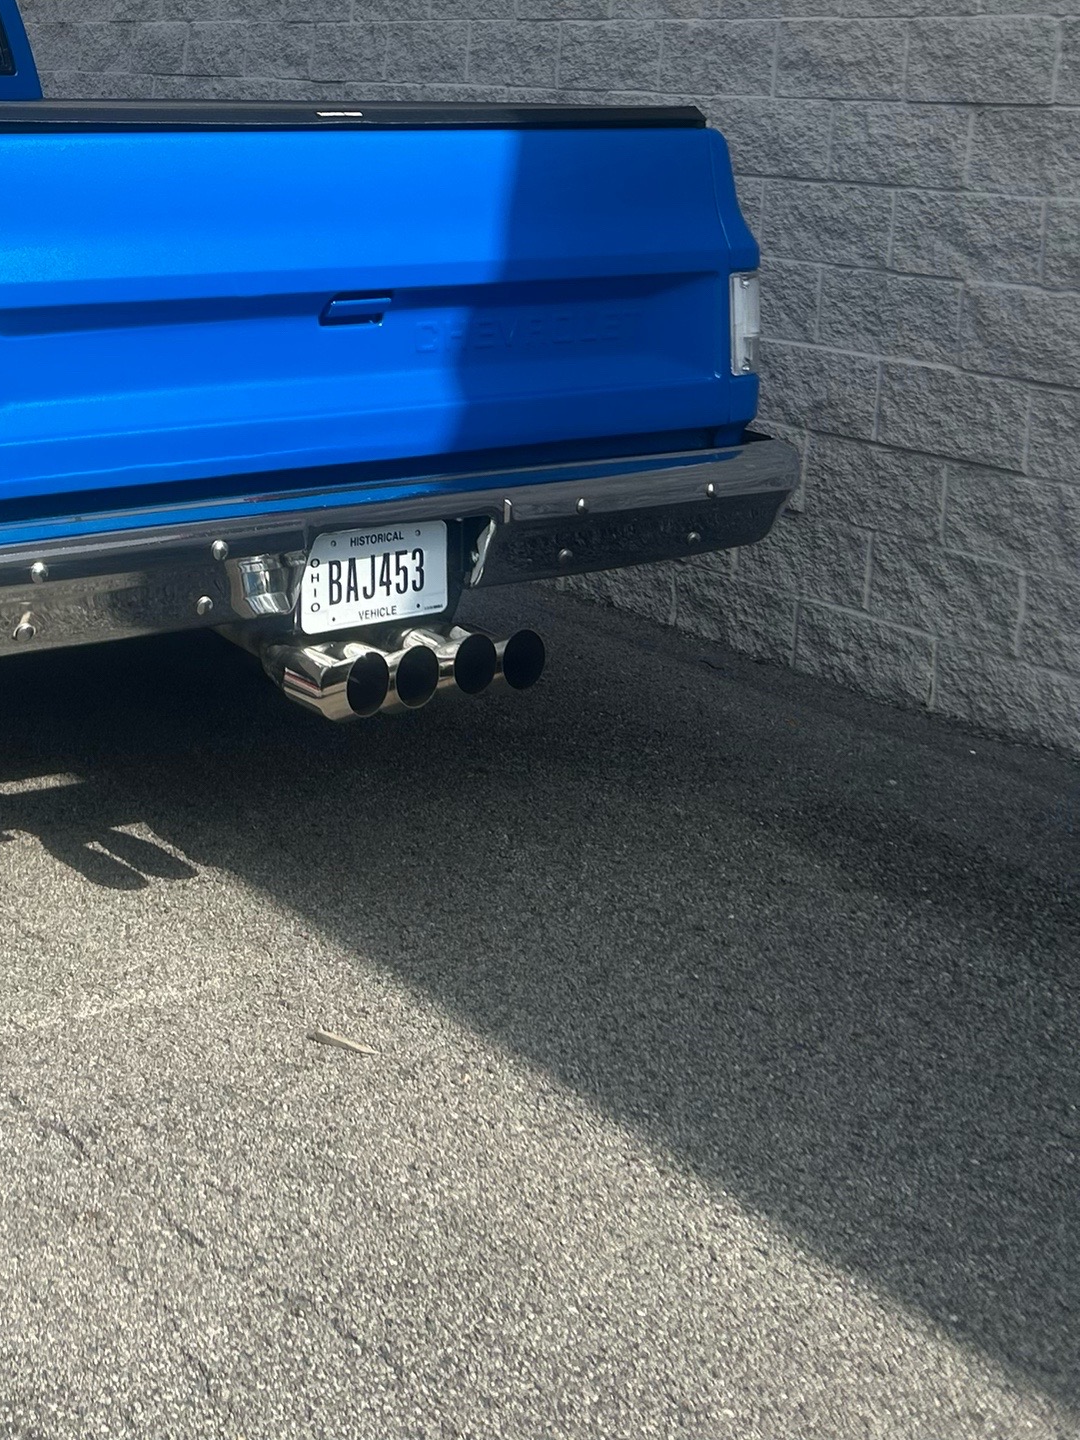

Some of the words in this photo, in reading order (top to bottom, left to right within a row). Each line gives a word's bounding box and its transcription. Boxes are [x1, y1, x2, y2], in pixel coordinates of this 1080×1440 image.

[350, 531, 404, 547] HISTORICAL
[310, 558, 320, 612] OHIO
[328, 548, 425, 606] BAJ453
[358, 605, 397, 621] VEHICLE
